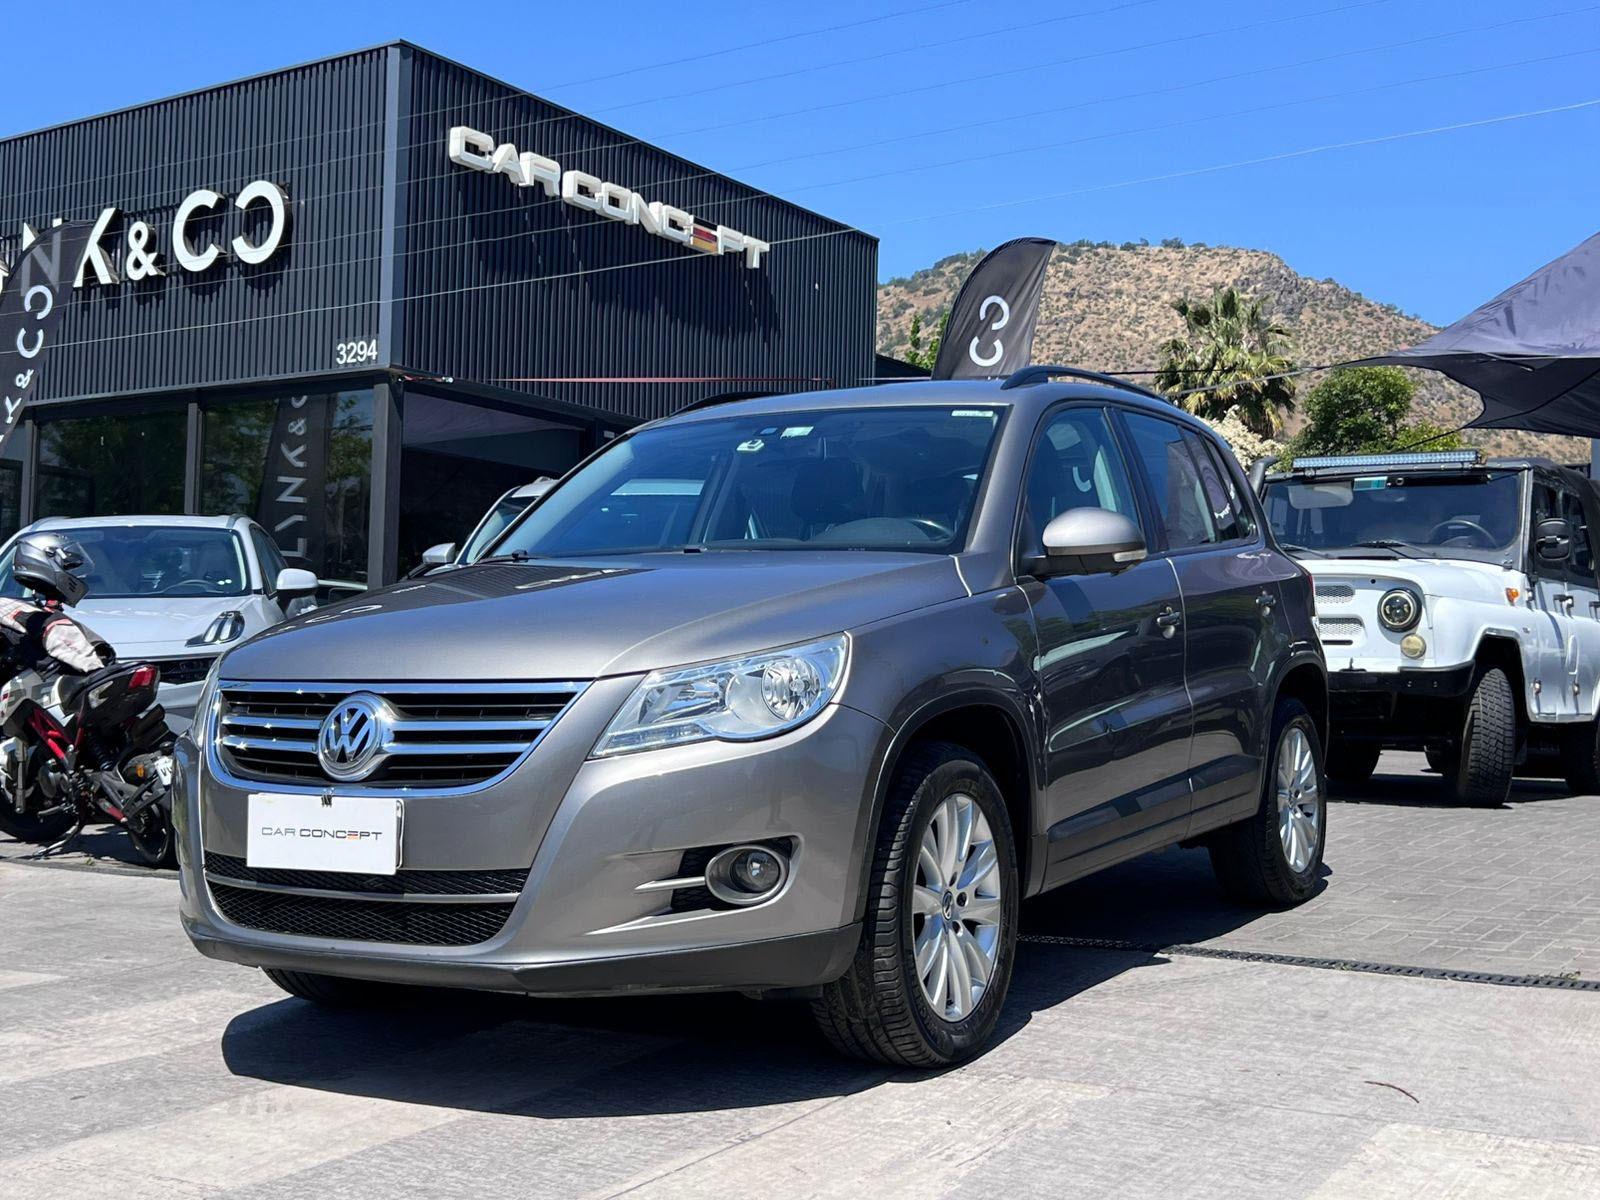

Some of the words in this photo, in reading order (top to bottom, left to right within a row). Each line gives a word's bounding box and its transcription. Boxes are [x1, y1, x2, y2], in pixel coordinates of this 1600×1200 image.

[449, 126, 561, 197] CAR
[562, 170, 770, 269] CONCEPT
[336, 339, 378, 365] 3294
[261, 827, 296, 837] CAR
[300, 828, 383, 840] CONCEPT
